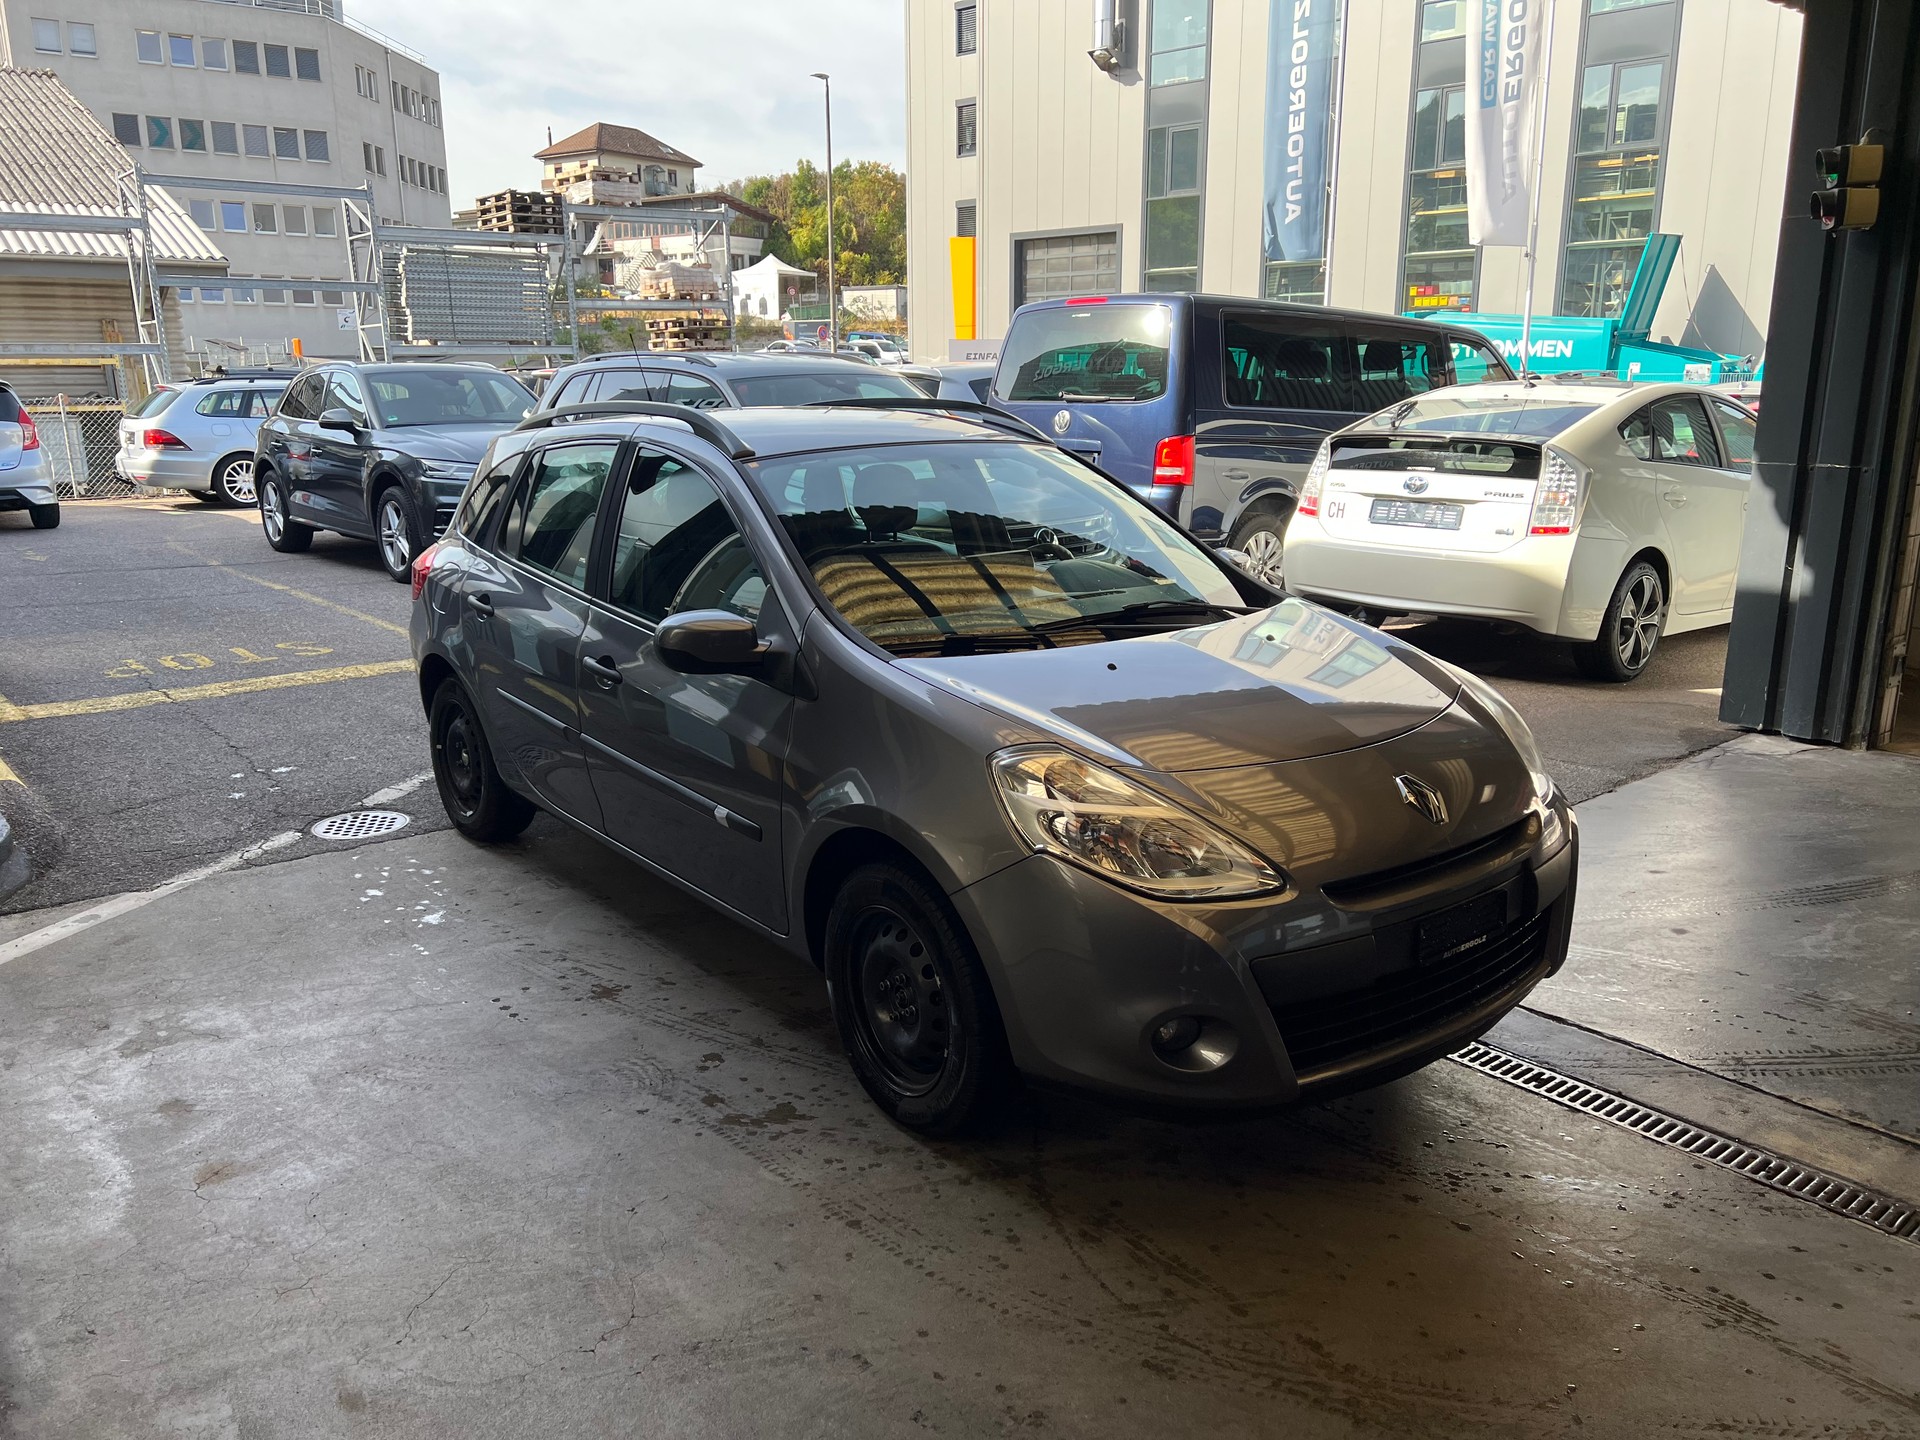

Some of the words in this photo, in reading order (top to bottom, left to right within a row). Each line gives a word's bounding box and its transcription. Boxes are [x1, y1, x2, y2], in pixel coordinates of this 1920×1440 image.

[1328, 502, 1346, 518] CH
[104, 641, 334, 678] STOP
[1443, 935, 1487, 958] AUTOERGOLZ
